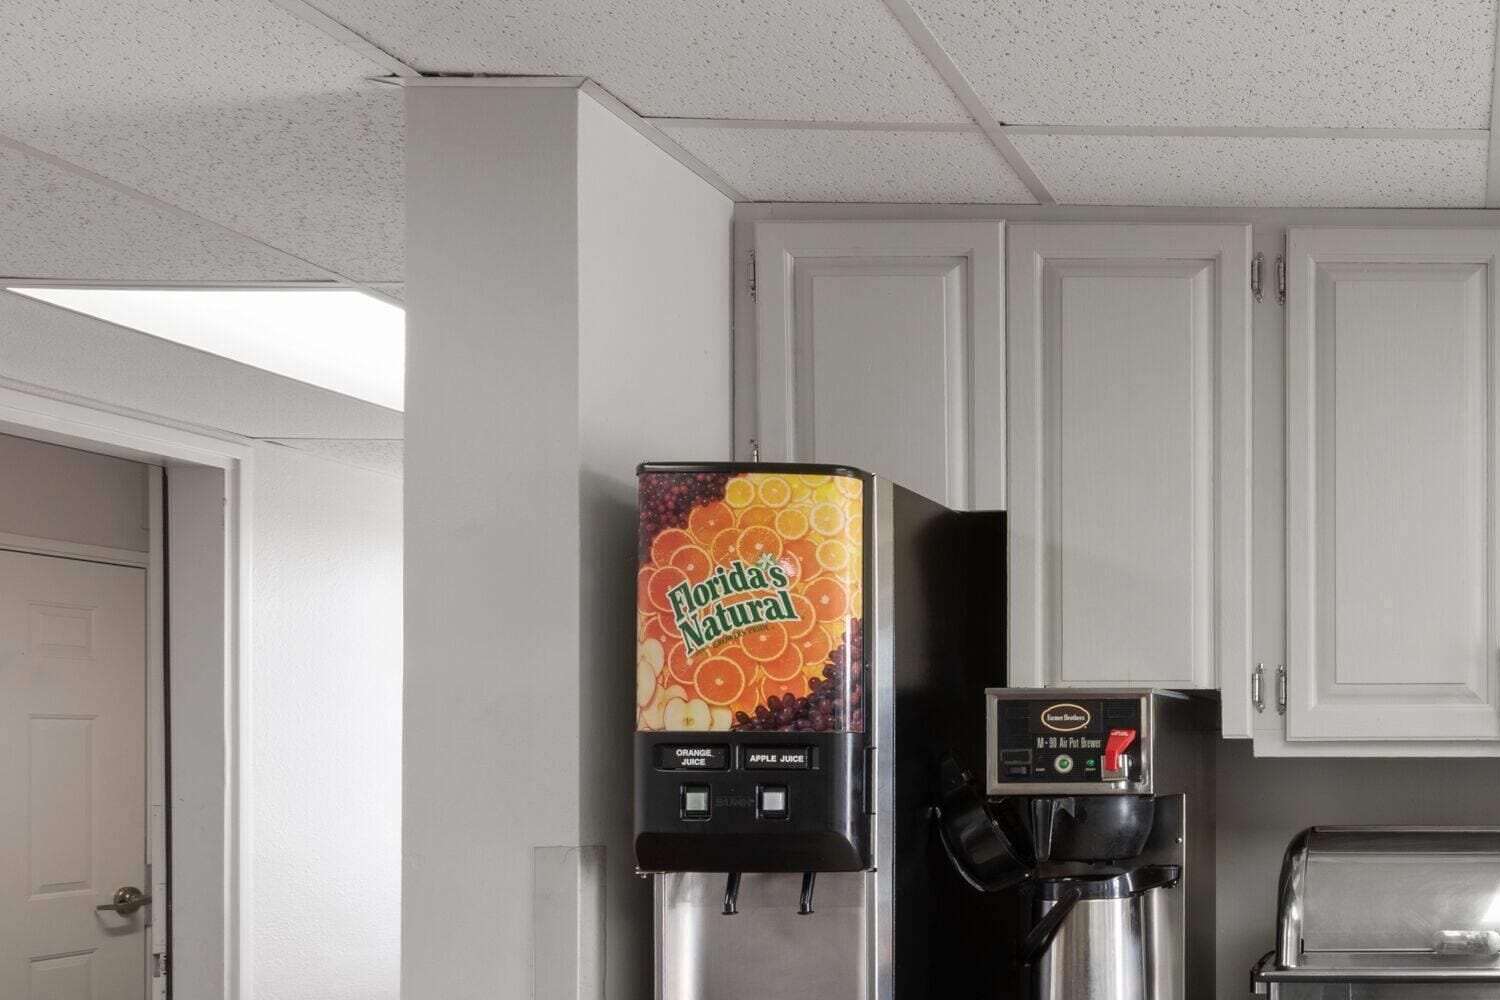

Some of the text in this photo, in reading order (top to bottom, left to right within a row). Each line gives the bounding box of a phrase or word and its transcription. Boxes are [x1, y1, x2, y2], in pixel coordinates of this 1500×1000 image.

[667, 560, 788, 622] Florida's
[679, 590, 799, 655] Natural
[1059, 737, 1068, 748] Air
[1069, 737, 1079, 748] Pot
[1081, 737, 1101, 748] Brewer
[676, 749, 712, 757] ORANGE
[681, 758, 706, 766] JUICE
[750, 755, 804, 763] APPLE JUICE
